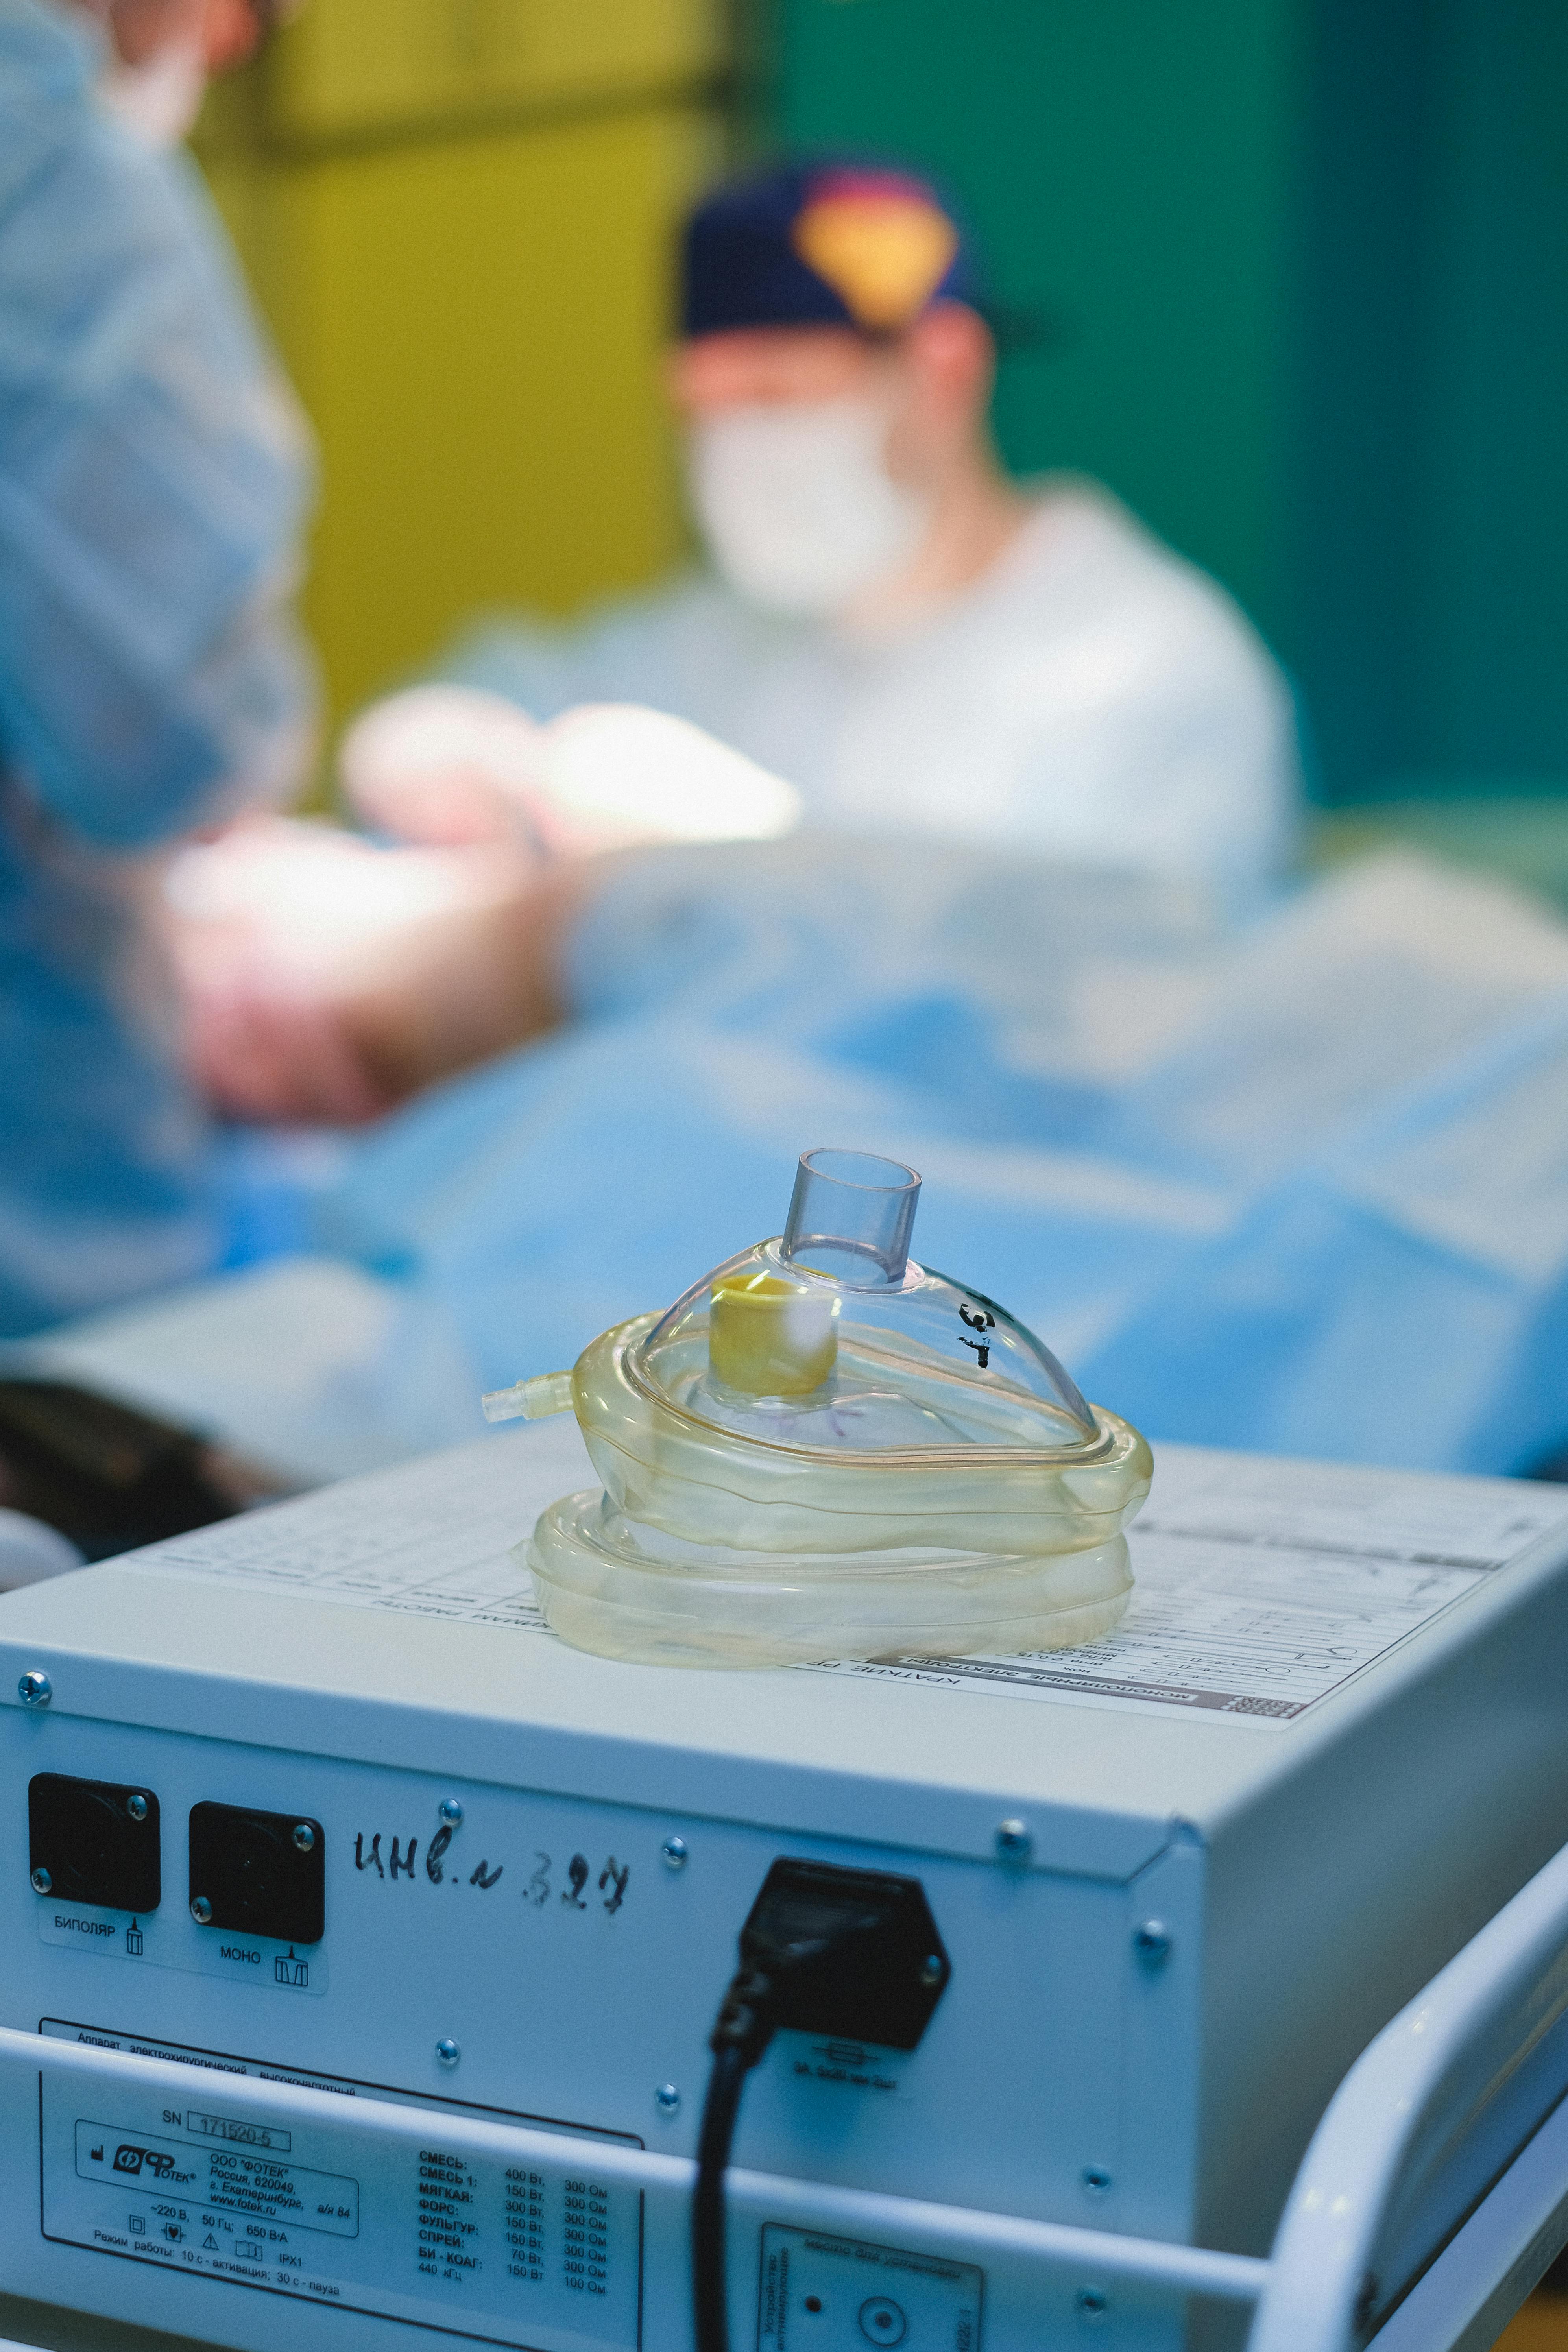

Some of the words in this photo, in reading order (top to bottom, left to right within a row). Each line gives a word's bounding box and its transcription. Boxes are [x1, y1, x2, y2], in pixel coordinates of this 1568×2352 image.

[851, 1665, 960, 1684] КРАТКИЕ
[907, 1657, 1019, 1676] ЭЛЕКТРОДЫ
[1027, 1674, 1190, 1698] МОНОПОЛЯРНЫЕ
[55, 1915, 116, 1937] БИПОЛЯР
[221, 1946, 261, 1964] МОНО
[78, 2032, 120, 2050] Аппарат
[163, 2110, 181, 2125] SN
[211, 2153, 237, 2168] ООО
[241, 2160, 288, 2178] "ФОТЕК"
[419, 2151, 467, 2169] СМЕСЬ:
[505, 2168, 526, 2181] 400
[529, 2172, 545, 2186] Вт,
[565, 2179, 585, 2193] 300
[590, 2184, 607, 2198] Ом
[211, 2167, 250, 2185] Россия,
[255, 2176, 296, 2194] 620049,
[419, 2166, 464, 2184] СМЕСЬ
[467, 2175, 478, 2187] 1:
[507, 2184, 526, 2197] 150
[529, 2188, 545, 2203] Вт,
[565, 2195, 585, 2209] 300
[590, 2201, 607, 2214] Ом
[211, 2193, 276, 2215] www.fotek.ru
[222, 2182, 304, 2210] Екатеринбург,
[318, 2204, 334, 2216] а/я
[337, 2206, 350, 2218] 84
[419, 2182, 473, 2203] МЯГКАЯ:
[505, 2200, 526, 2214] 300
[529, 2204, 545, 2219] Вт,
[564, 2212, 585, 2225] 300
[589, 2217, 607, 2231] Ом
[202, 2214, 215, 2226] 50
[247, 2225, 266, 2238] 650
[419, 2199, 459, 2215] ФОРС:
[506, 2216, 526, 2229] 150
[528, 2220, 544, 2234] Вт,
[564, 2228, 585, 2242] 300
[589, 2232, 607, 2247] Ом
[419, 2214, 479, 2236] ФУЛЬГУР:
[506, 2232, 526, 2245] 150
[528, 2236, 544, 2250] Вт,
[564, 2244, 584, 2258] 300
[588, 2249, 606, 2263] Ом
[94, 2230, 128, 2247] Режим
[134, 2239, 175, 2258] работы:
[182, 2250, 194, 2262] 10
[212, 2260, 271, 2280] активация;
[277, 2272, 290, 2284] 30
[293, 2277, 299, 2286] с
[309, 2281, 340, 2296] пауза
[279, 2253, 302, 2267] IPX1
[419, 2229, 464, 2249] СПРЕЙ:
[512, 2249, 525, 2261] 70
[528, 2252, 544, 2266] Вт,
[563, 2259, 584, 2274] 300
[588, 2265, 606, 2278] Ом
[855, 2248, 879, 2263] для
[419, 2246, 436, 2259] БИ
[447, 2252, 482, 2269] КОАГ:
[507, 2263, 527, 2277] 150
[531, 2267, 543, 2280] Вт
[564, 2276, 584, 2289] 100
[588, 2280, 606, 2294] Ом
[419, 2262, 437, 2274] 440
[443, 2269, 462, 2282] кГц
[765, 2254, 778, 2334] Устройство
[777, 2247, 789, 2351] активирующее
